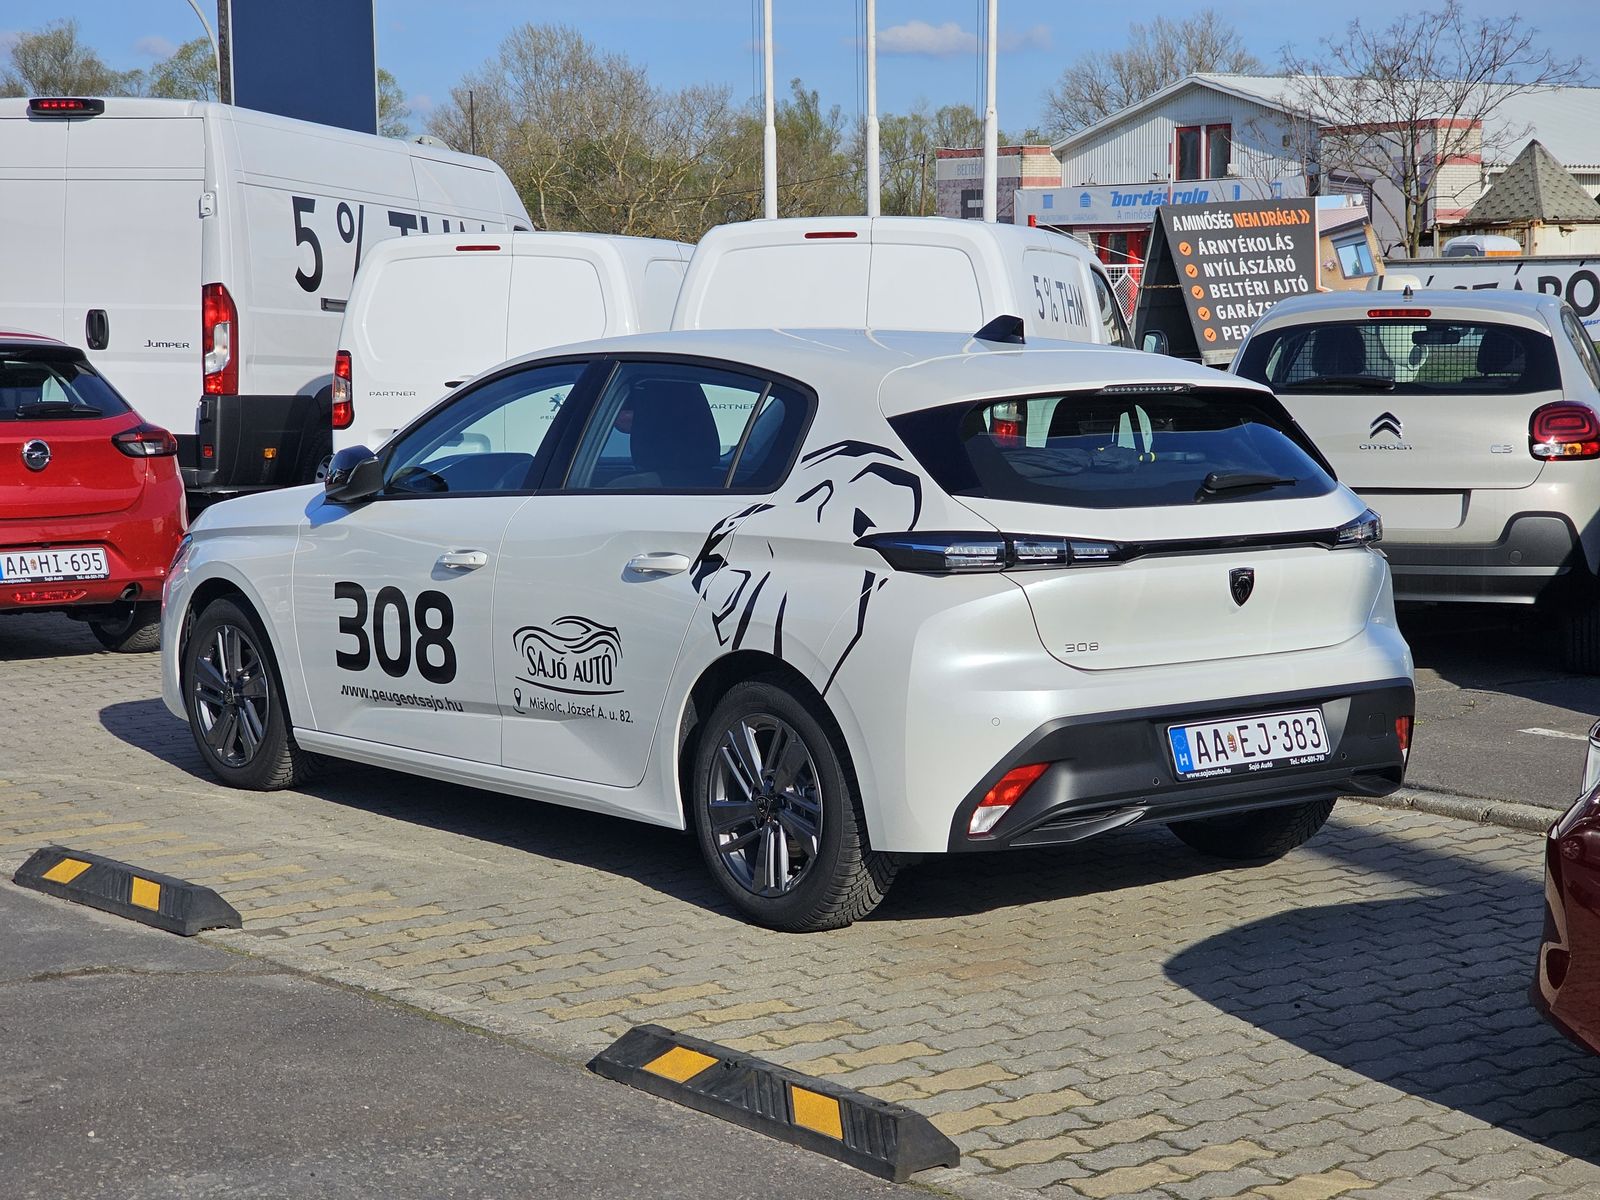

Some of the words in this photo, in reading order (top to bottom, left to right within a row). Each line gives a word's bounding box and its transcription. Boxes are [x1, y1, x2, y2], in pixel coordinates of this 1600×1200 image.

[1173, 216, 1182, 231] A
[1182, 210, 1234, 231] MINŐSÉG
[1233, 211, 1260, 228] NEM
[1260, 208, 1300, 227] DRÁGA
[1198, 232, 1294, 255] ÁRNYÉKOLÁS
[1203, 254, 1296, 278] NYÍLÁSZÁRÓ
[1209, 279, 1270, 299] BELTÉRI
[1274, 275, 1309, 294] AJTÓ
[1055, 281, 1087, 327] THM
[1216, 300, 1278, 320] GARÁZS
[1222, 324, 1254, 341] PER
[1490, 445, 1513, 453] C3
[6, 556, 30, 575] AA
[37, 552, 103, 573] HI-695
[334, 581, 457, 684] 308
[1065, 641, 1099, 653] 308
[526, 645, 567, 680] SAJÓ
[573, 647, 612, 686] AUTÓ
[340, 684, 464, 713] www.peugeotsajo.hu
[529, 696, 565, 715] Miskolc,
[568, 701, 595, 716] József
[597, 706, 607, 719] A.
[609, 711, 618, 721] u.
[620, 709, 634, 723] 82.
[1196, 729, 1230, 764] AA
[1237, 717, 1321, 758] EJ-383
[1179, 753, 1189, 766] H
